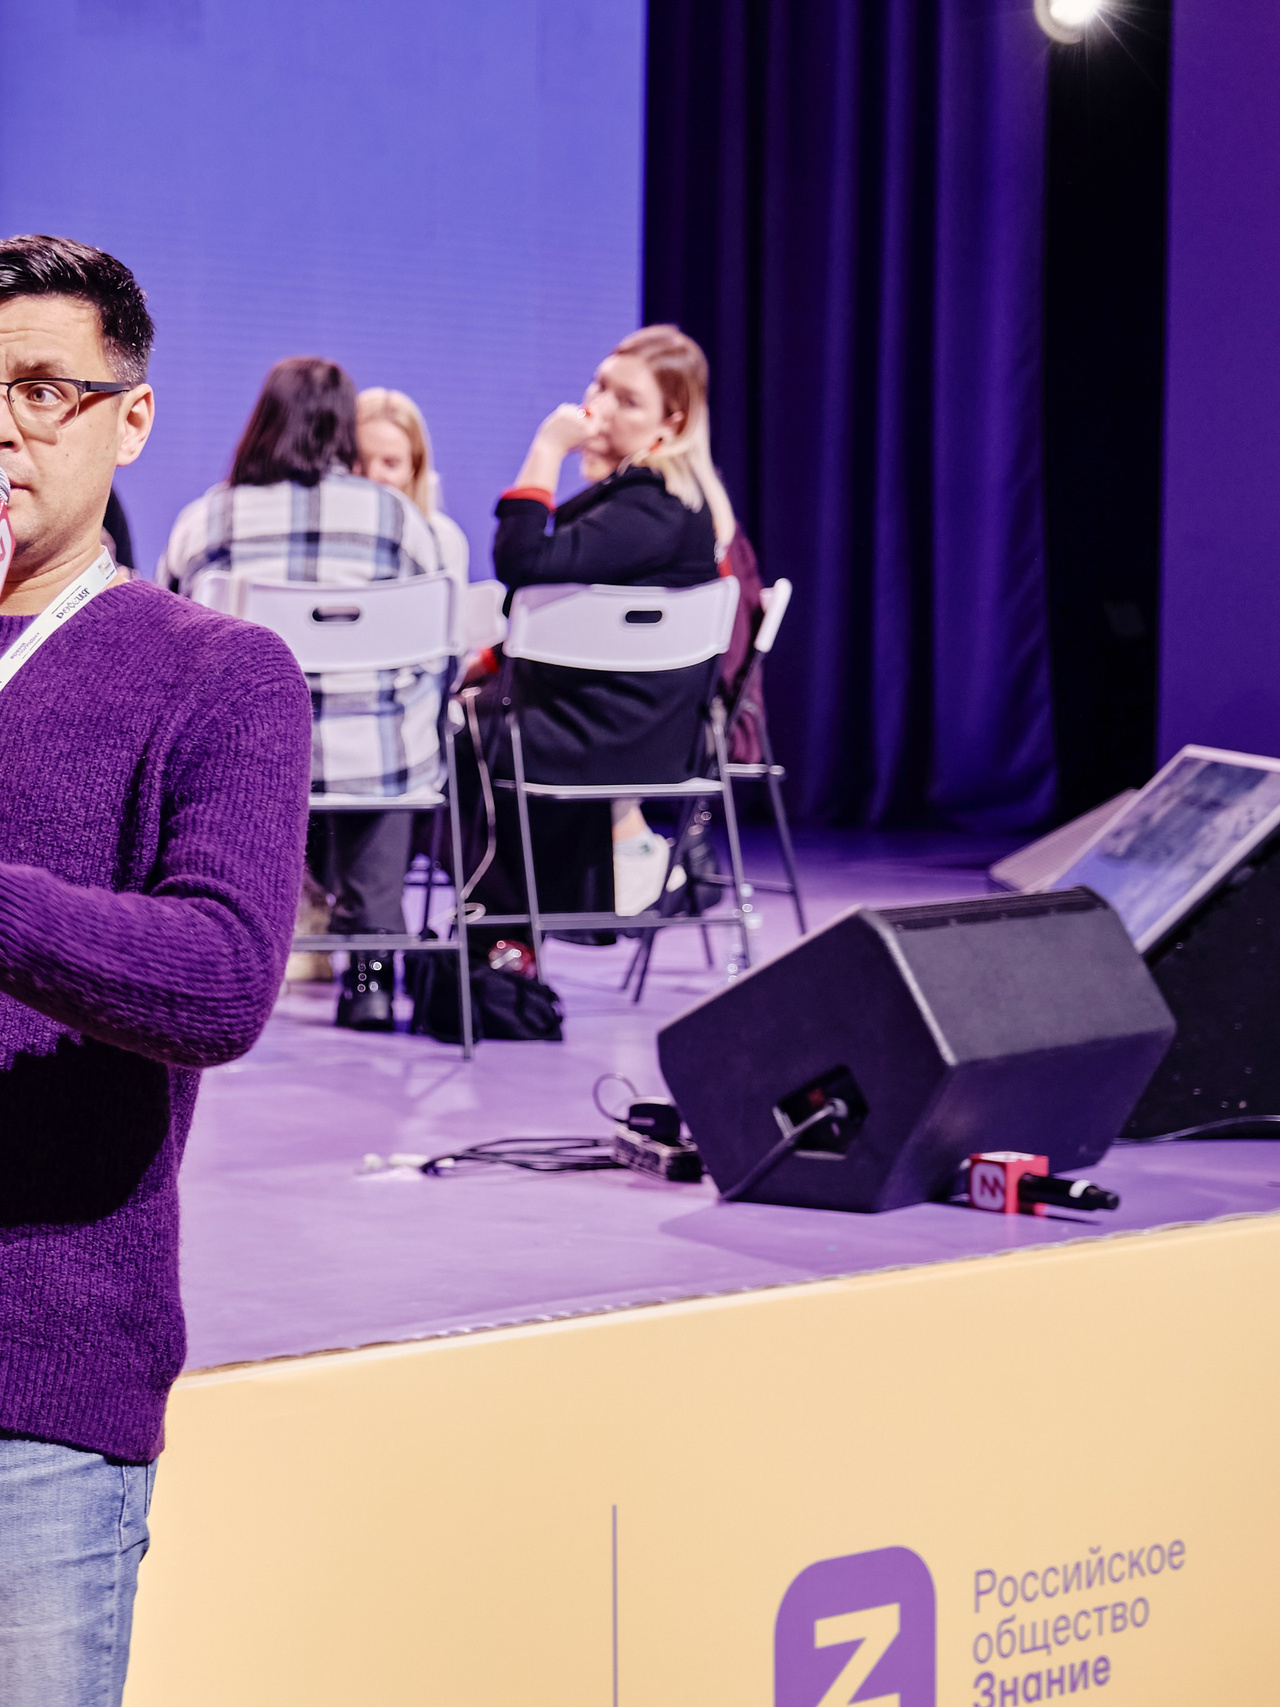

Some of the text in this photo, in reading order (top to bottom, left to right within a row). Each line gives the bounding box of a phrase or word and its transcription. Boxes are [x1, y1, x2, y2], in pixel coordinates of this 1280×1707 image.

[973, 1539, 1187, 1613] Российское
[972, 1597, 1151, 1664] общество
[972, 1655, 1112, 1707] Знание
